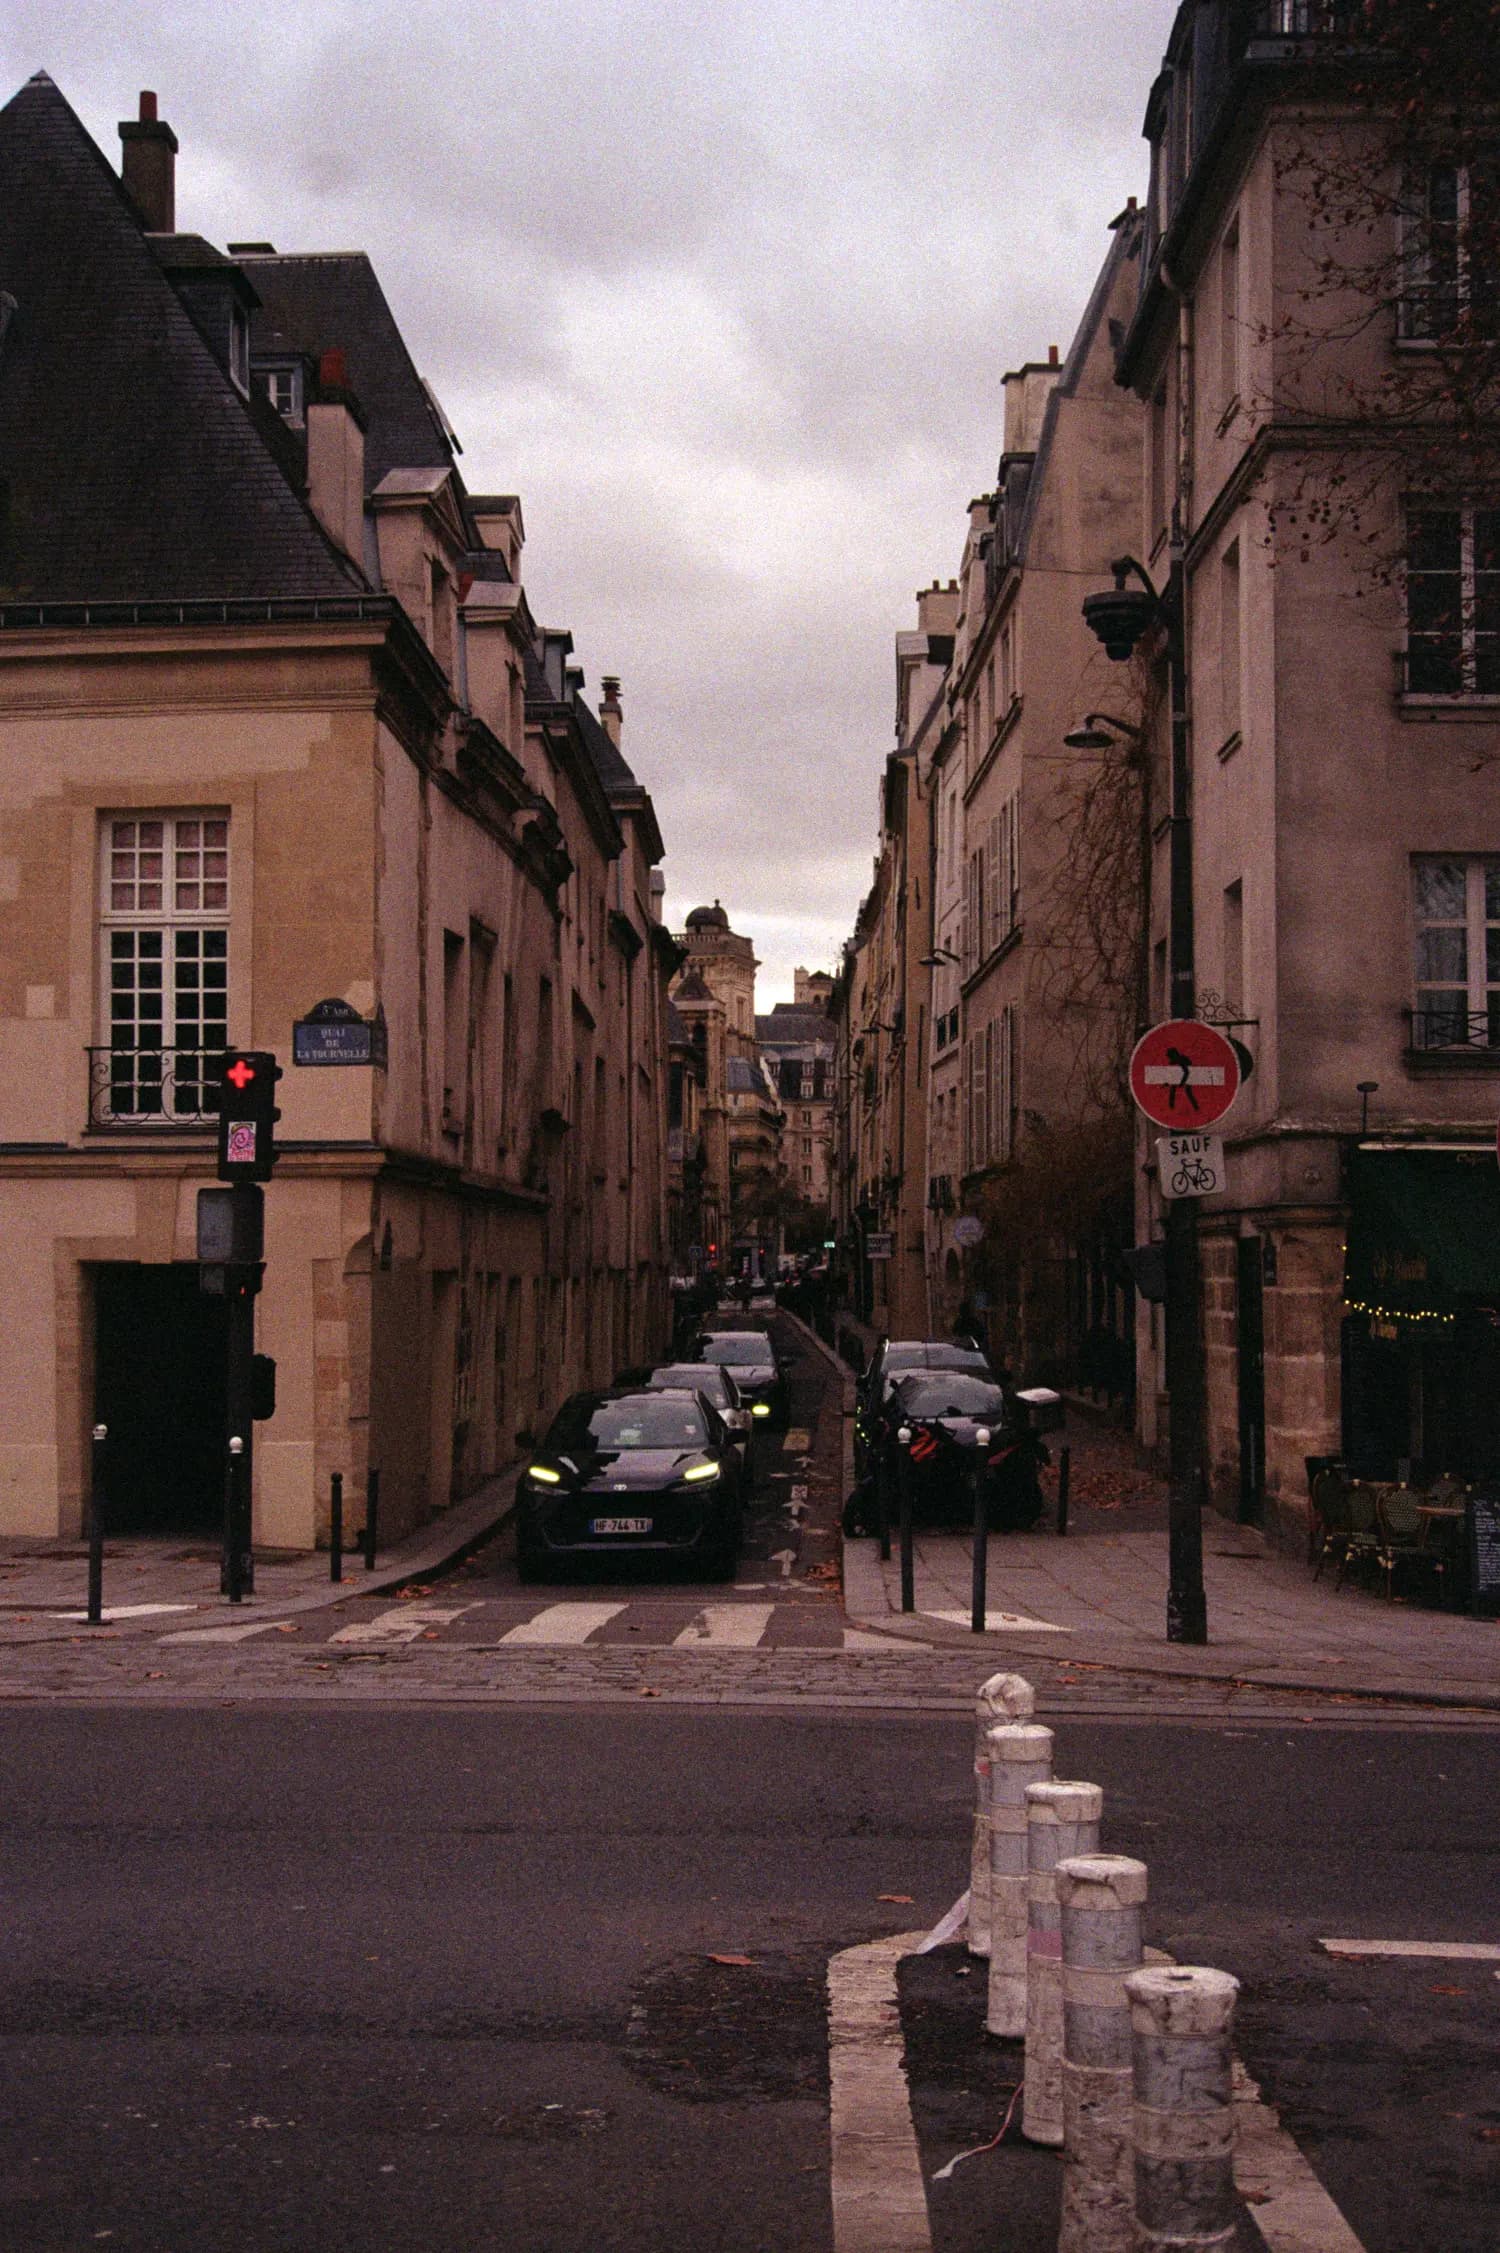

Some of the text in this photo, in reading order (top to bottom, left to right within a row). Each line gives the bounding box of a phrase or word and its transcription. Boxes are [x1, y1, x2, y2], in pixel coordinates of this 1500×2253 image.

[321, 1028, 346, 1039] QUAI
[325, 1039, 340, 1048] DE
[297, 1049, 369, 1060] LA TOURNELLE
[1170, 1136, 1211, 1155] SAUF
